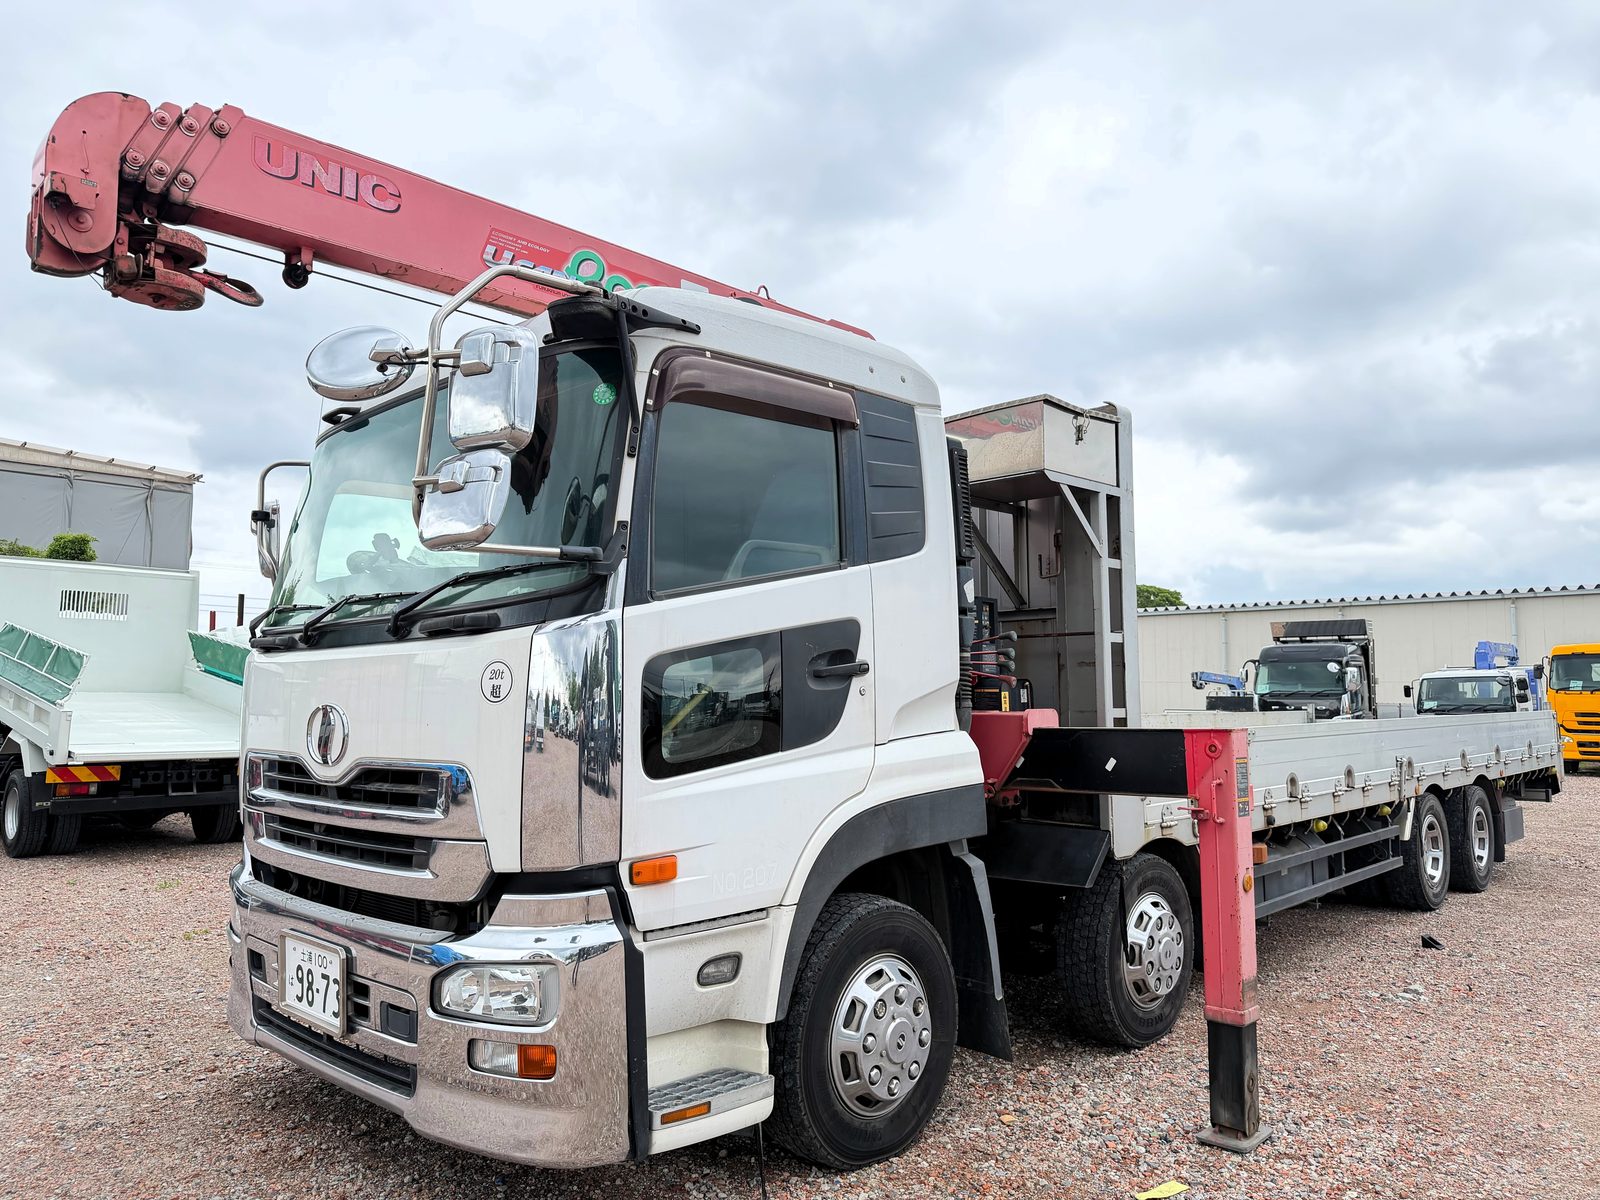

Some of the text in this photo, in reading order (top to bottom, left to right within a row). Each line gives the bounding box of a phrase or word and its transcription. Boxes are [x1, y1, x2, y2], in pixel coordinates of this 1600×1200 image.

[254, 136, 402, 213] UNIC
[528, 242, 550, 253] ECOLOGY
[489, 668, 505, 680] 20t
[490, 684, 502, 698] 超
[296, 964, 340, 1019] 98-73
